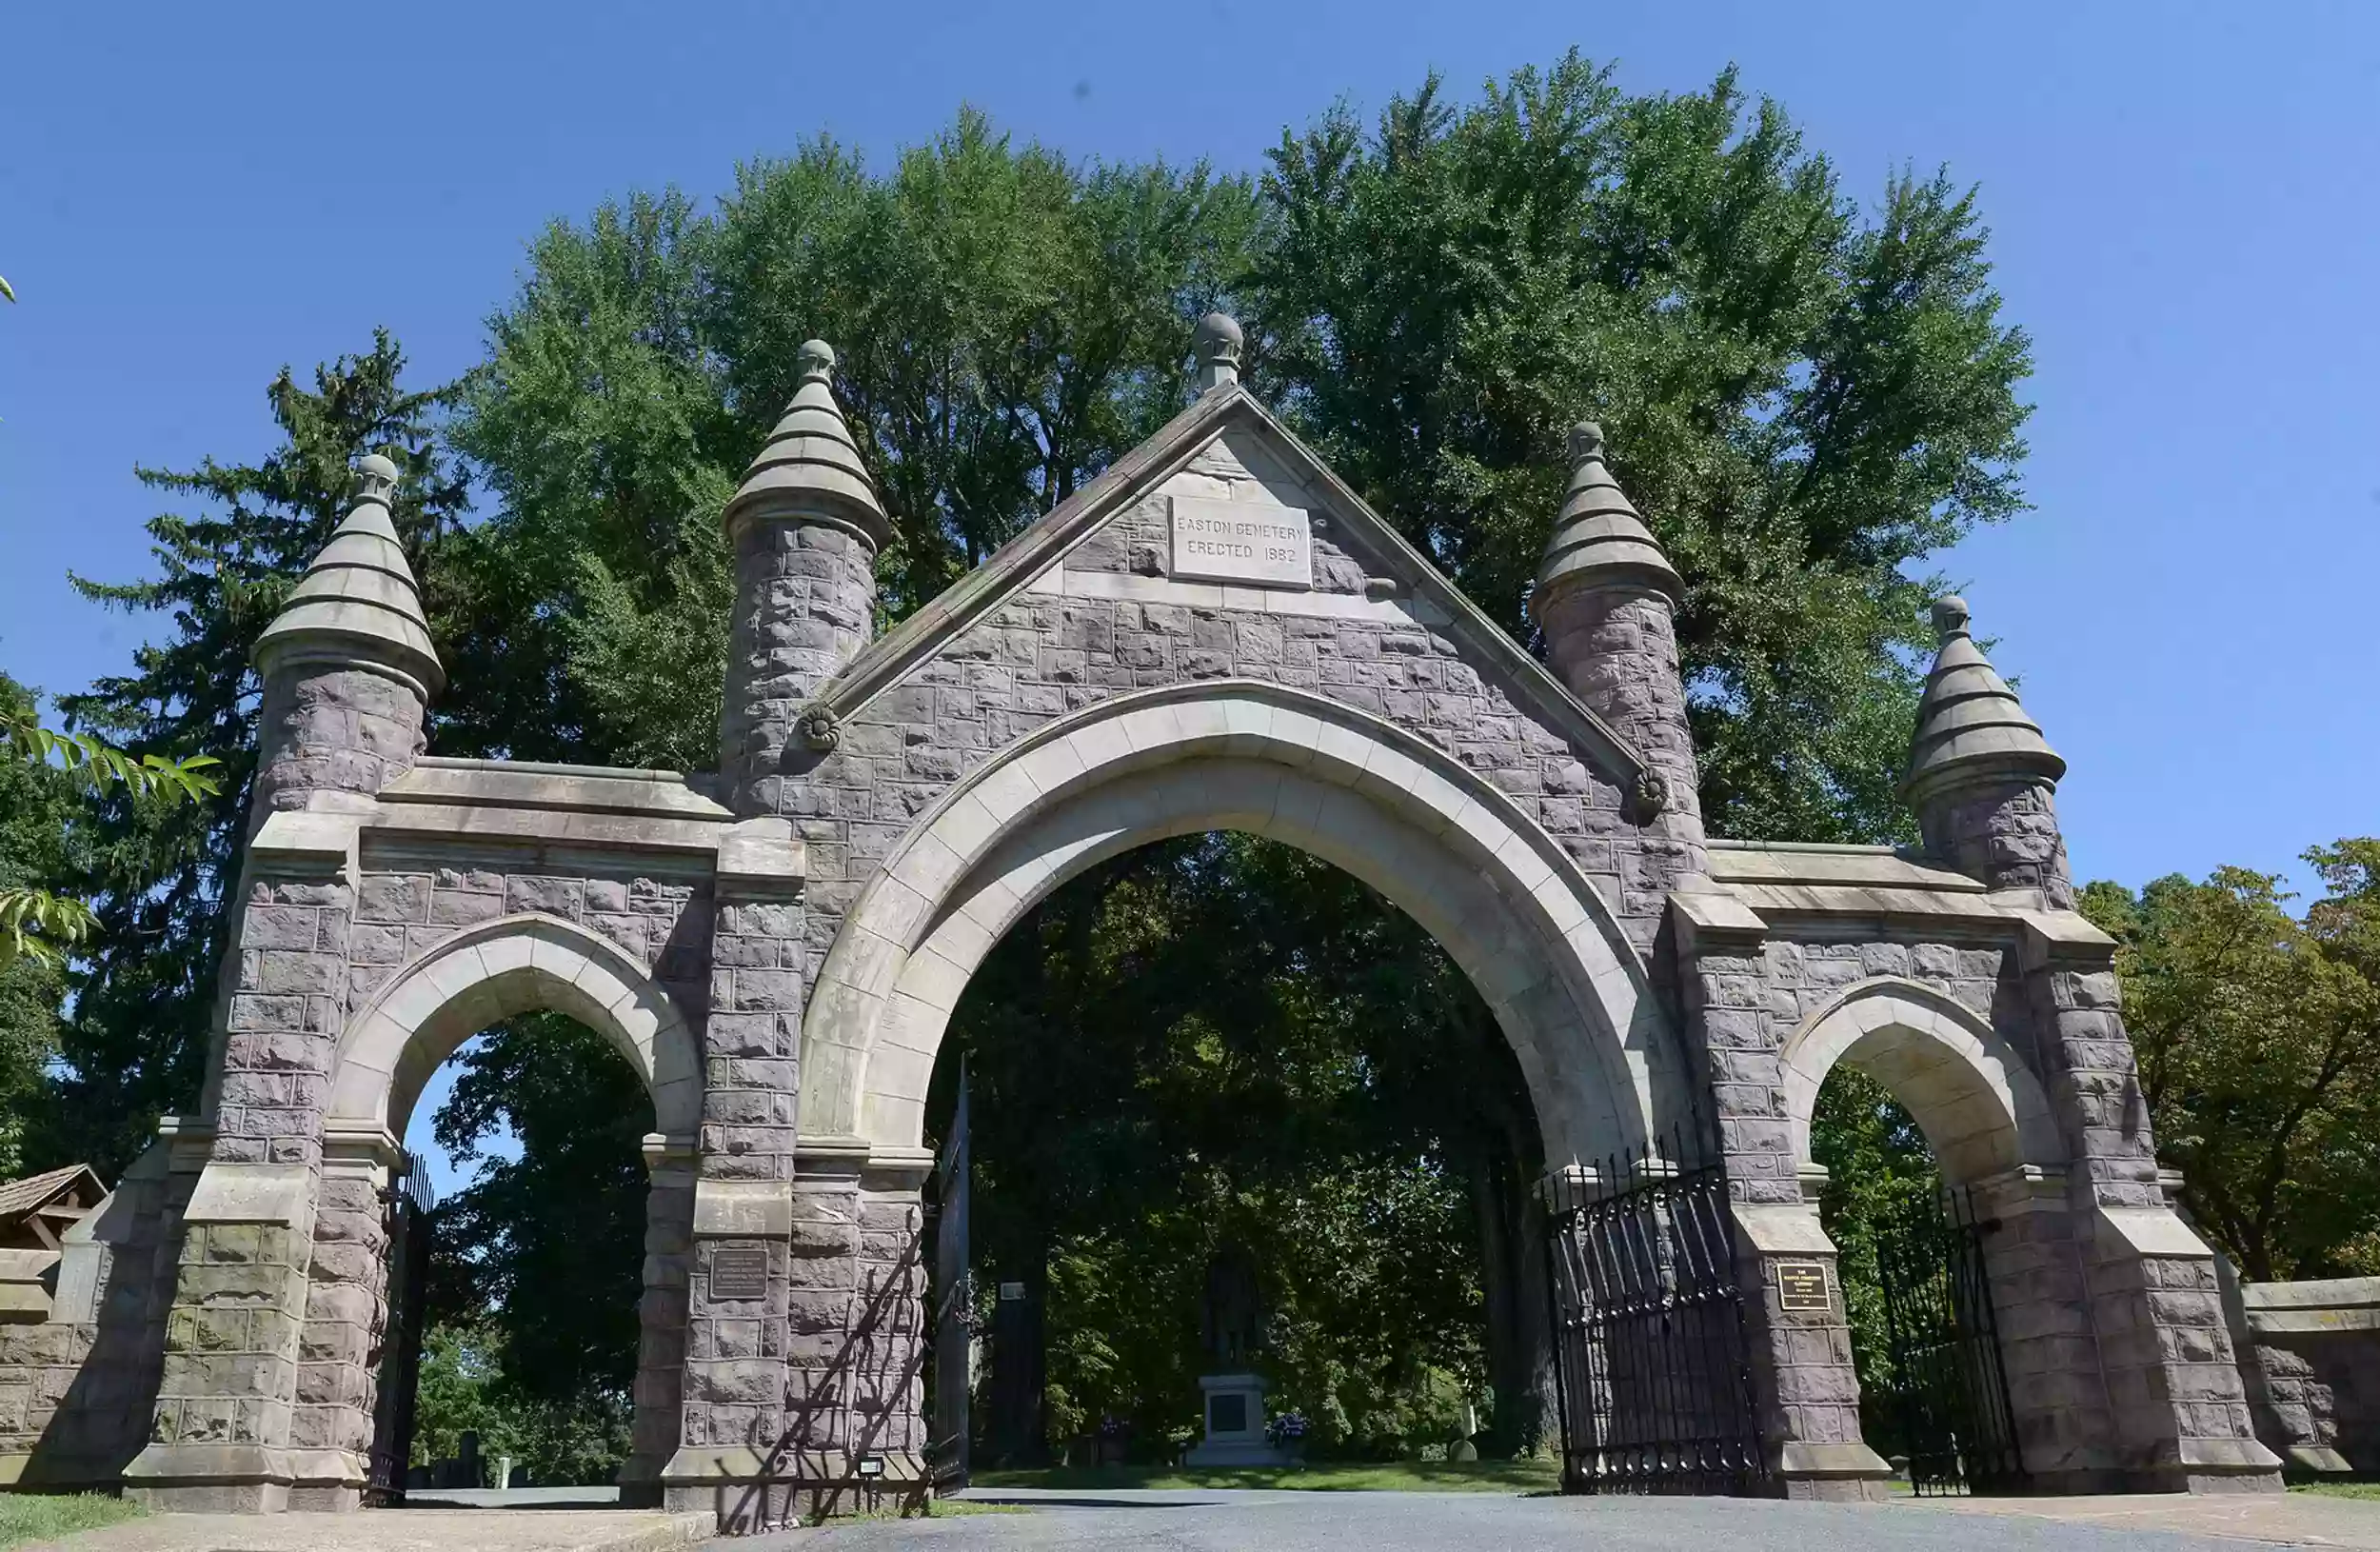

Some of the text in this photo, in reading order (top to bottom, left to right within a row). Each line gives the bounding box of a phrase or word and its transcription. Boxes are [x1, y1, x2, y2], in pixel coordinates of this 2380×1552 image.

[1177, 517, 1305, 540] EASTON CEMETERY
[1187, 540, 1298, 563] ERECTED 1882
